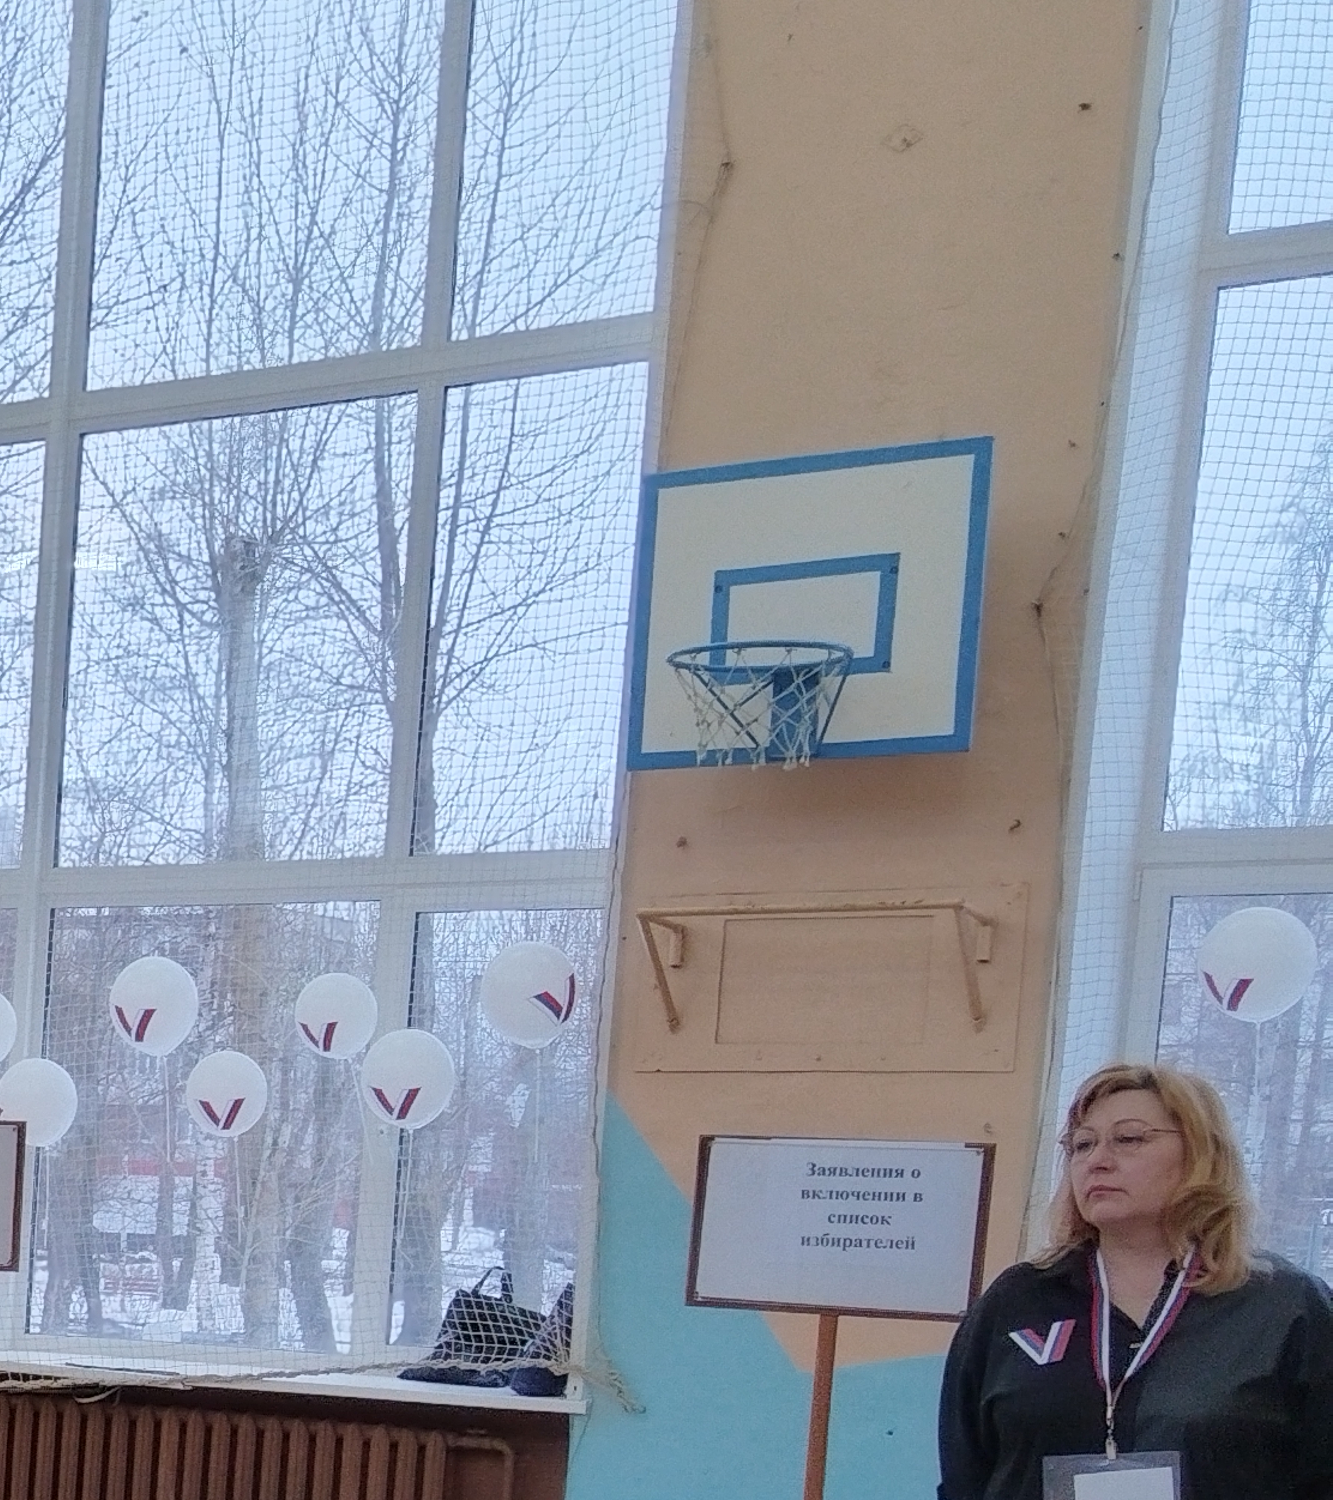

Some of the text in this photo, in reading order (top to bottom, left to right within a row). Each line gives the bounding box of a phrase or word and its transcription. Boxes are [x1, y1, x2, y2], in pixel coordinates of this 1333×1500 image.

[805, 1161, 921, 1180] Заявления о
[800, 1188, 924, 1204] включении в
[827, 1212, 892, 1226] список
[800, 1233, 916, 1252] избирателей
